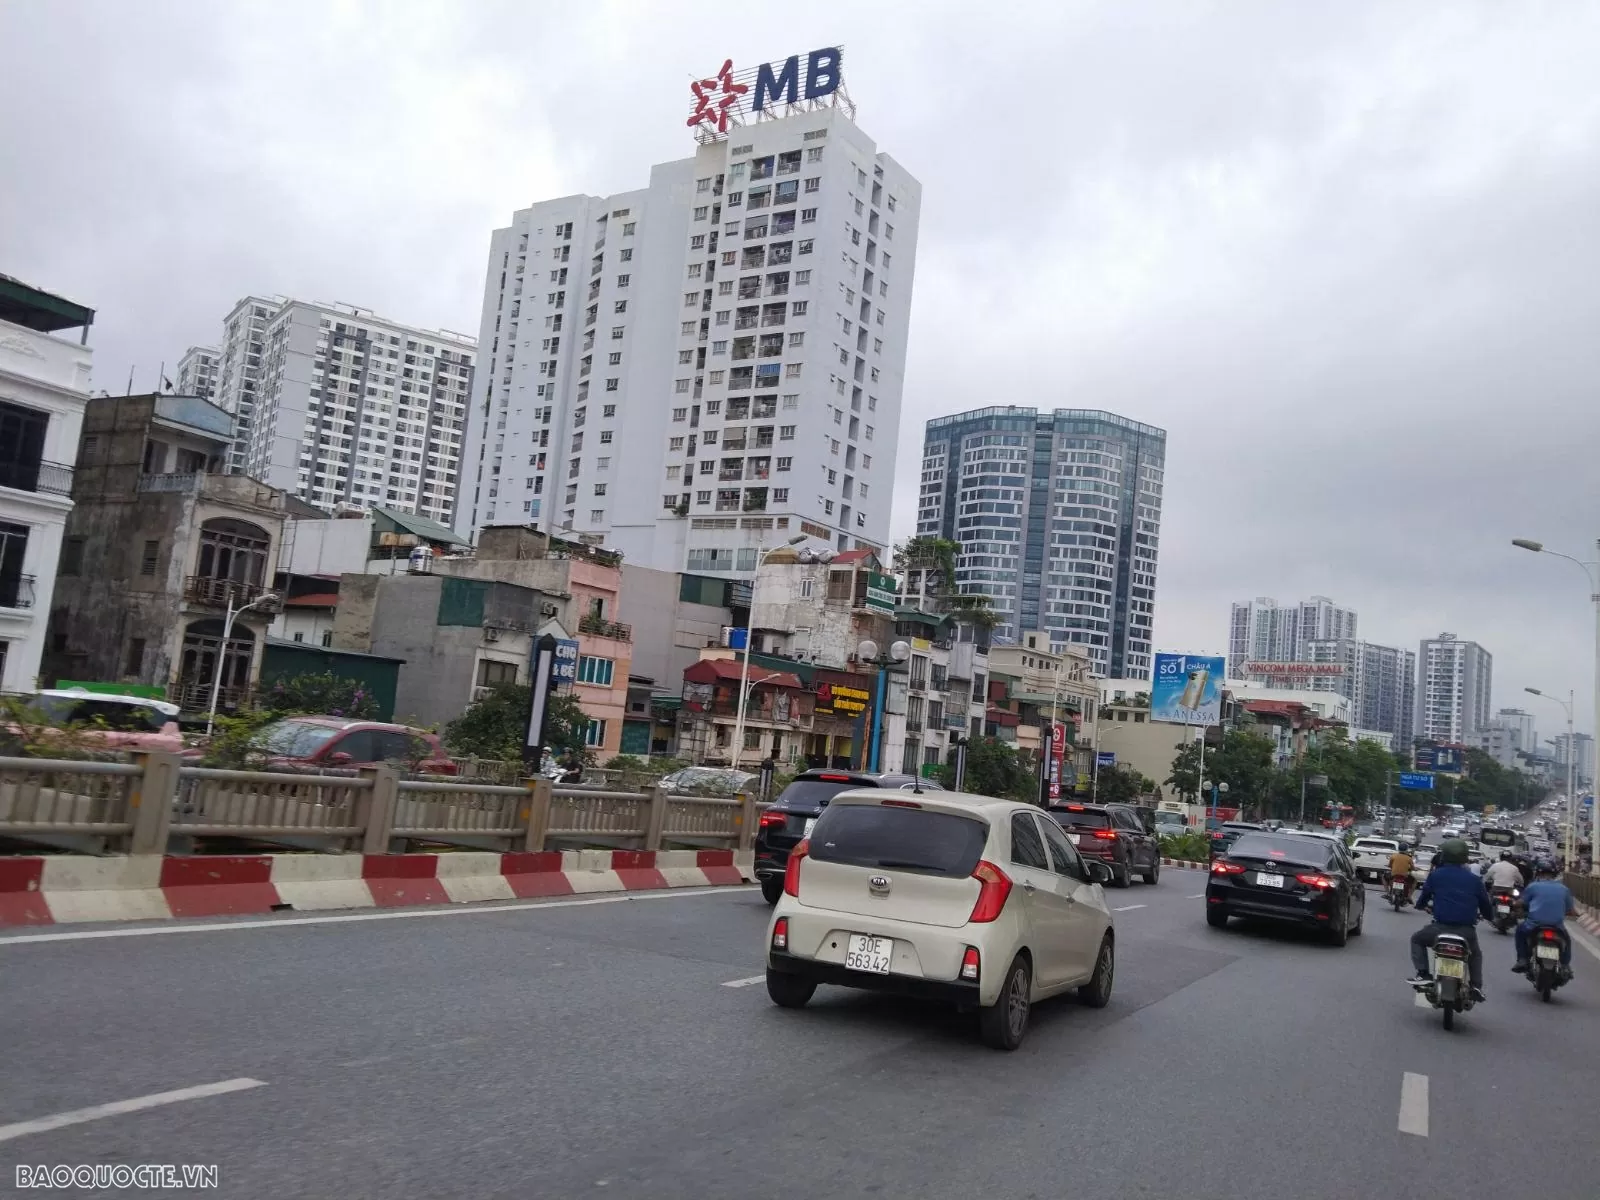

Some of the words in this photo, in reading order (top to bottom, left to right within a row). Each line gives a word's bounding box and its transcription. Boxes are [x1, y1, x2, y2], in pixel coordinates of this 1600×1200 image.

[753, 47, 841, 111] MB
[1178, 656, 1186, 674] 1
[1248, 664, 1285, 673] VINCOM
[1288, 664, 1315, 673] MEGA
[1316, 664, 1344, 674] MALL
[871, 878, 887, 887] KIA
[859, 937, 883, 955] 30E
[847, 952, 889, 973] 563.42
